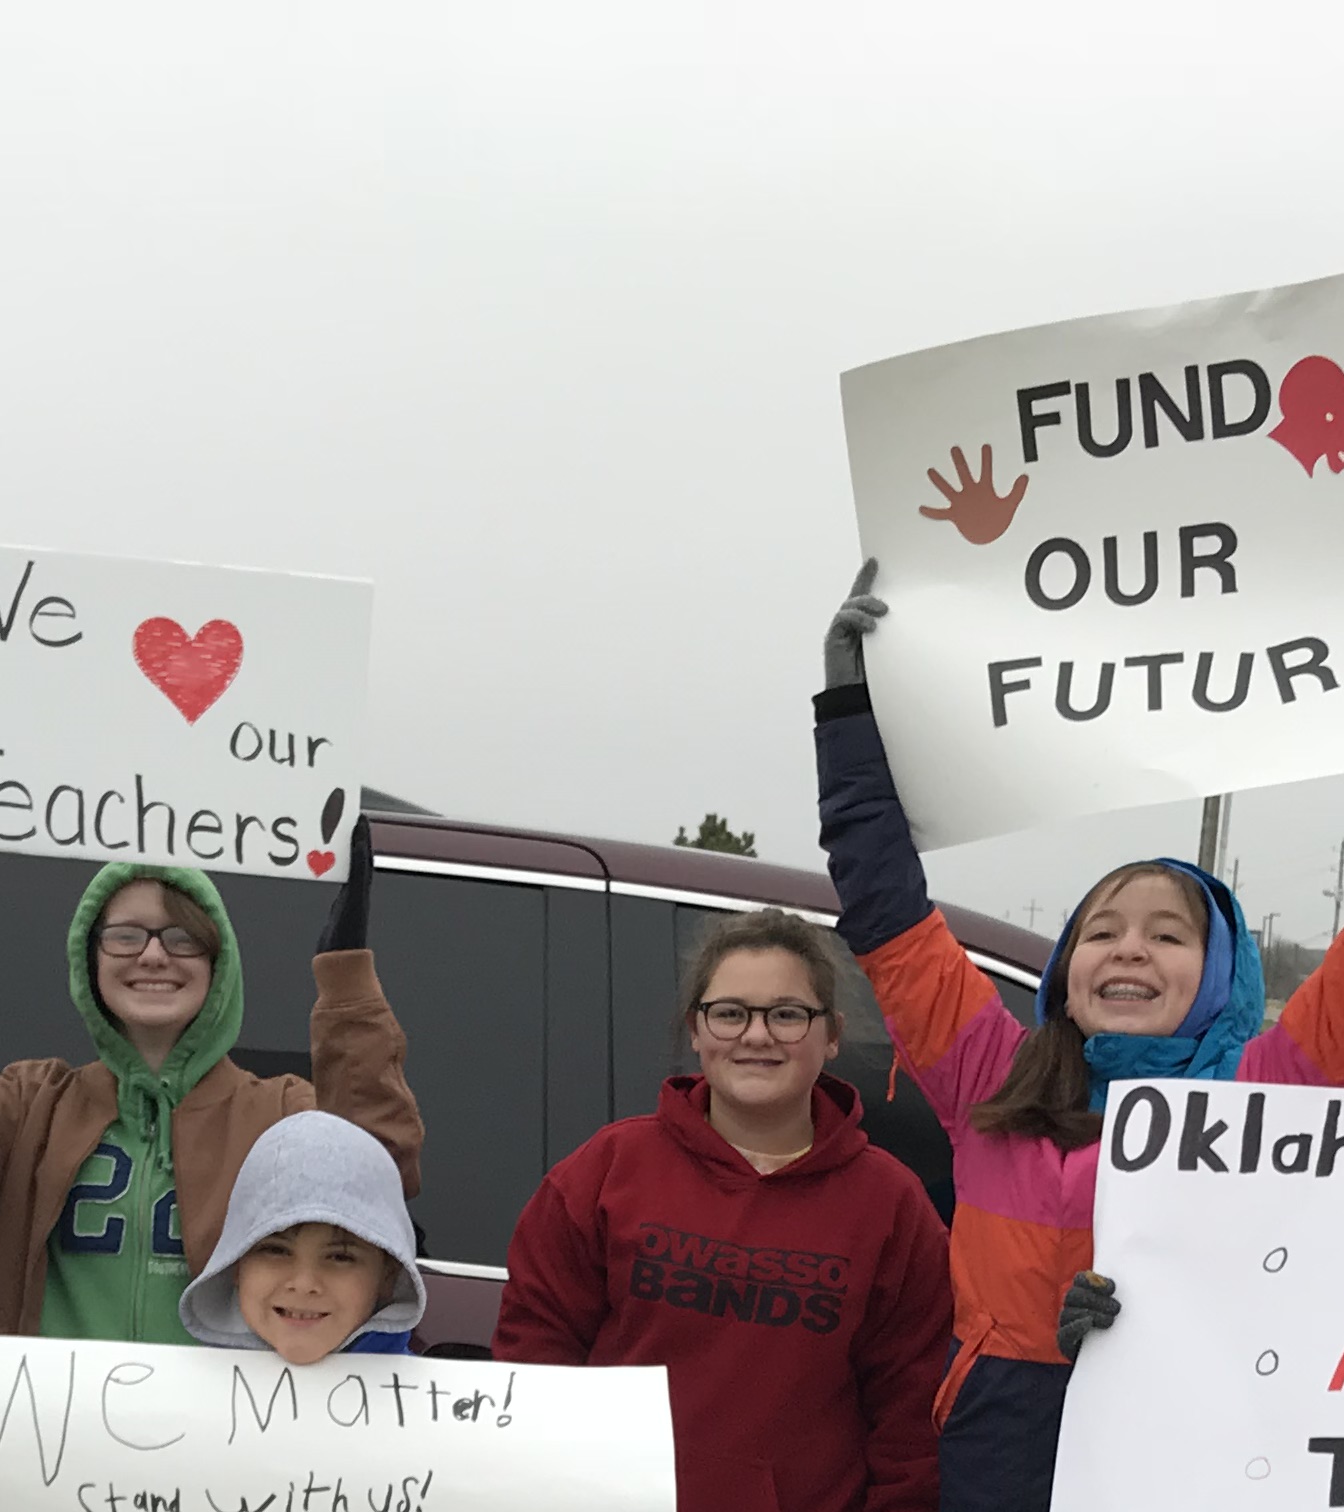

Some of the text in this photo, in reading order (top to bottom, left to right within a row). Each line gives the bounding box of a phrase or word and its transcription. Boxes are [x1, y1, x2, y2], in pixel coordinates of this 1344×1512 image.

[1016, 359, 1271, 463] FUND
[1025, 521, 1238, 611] OUR
[229, 722, 332, 767] our
[228, 1364, 516, 1445] Matter!
